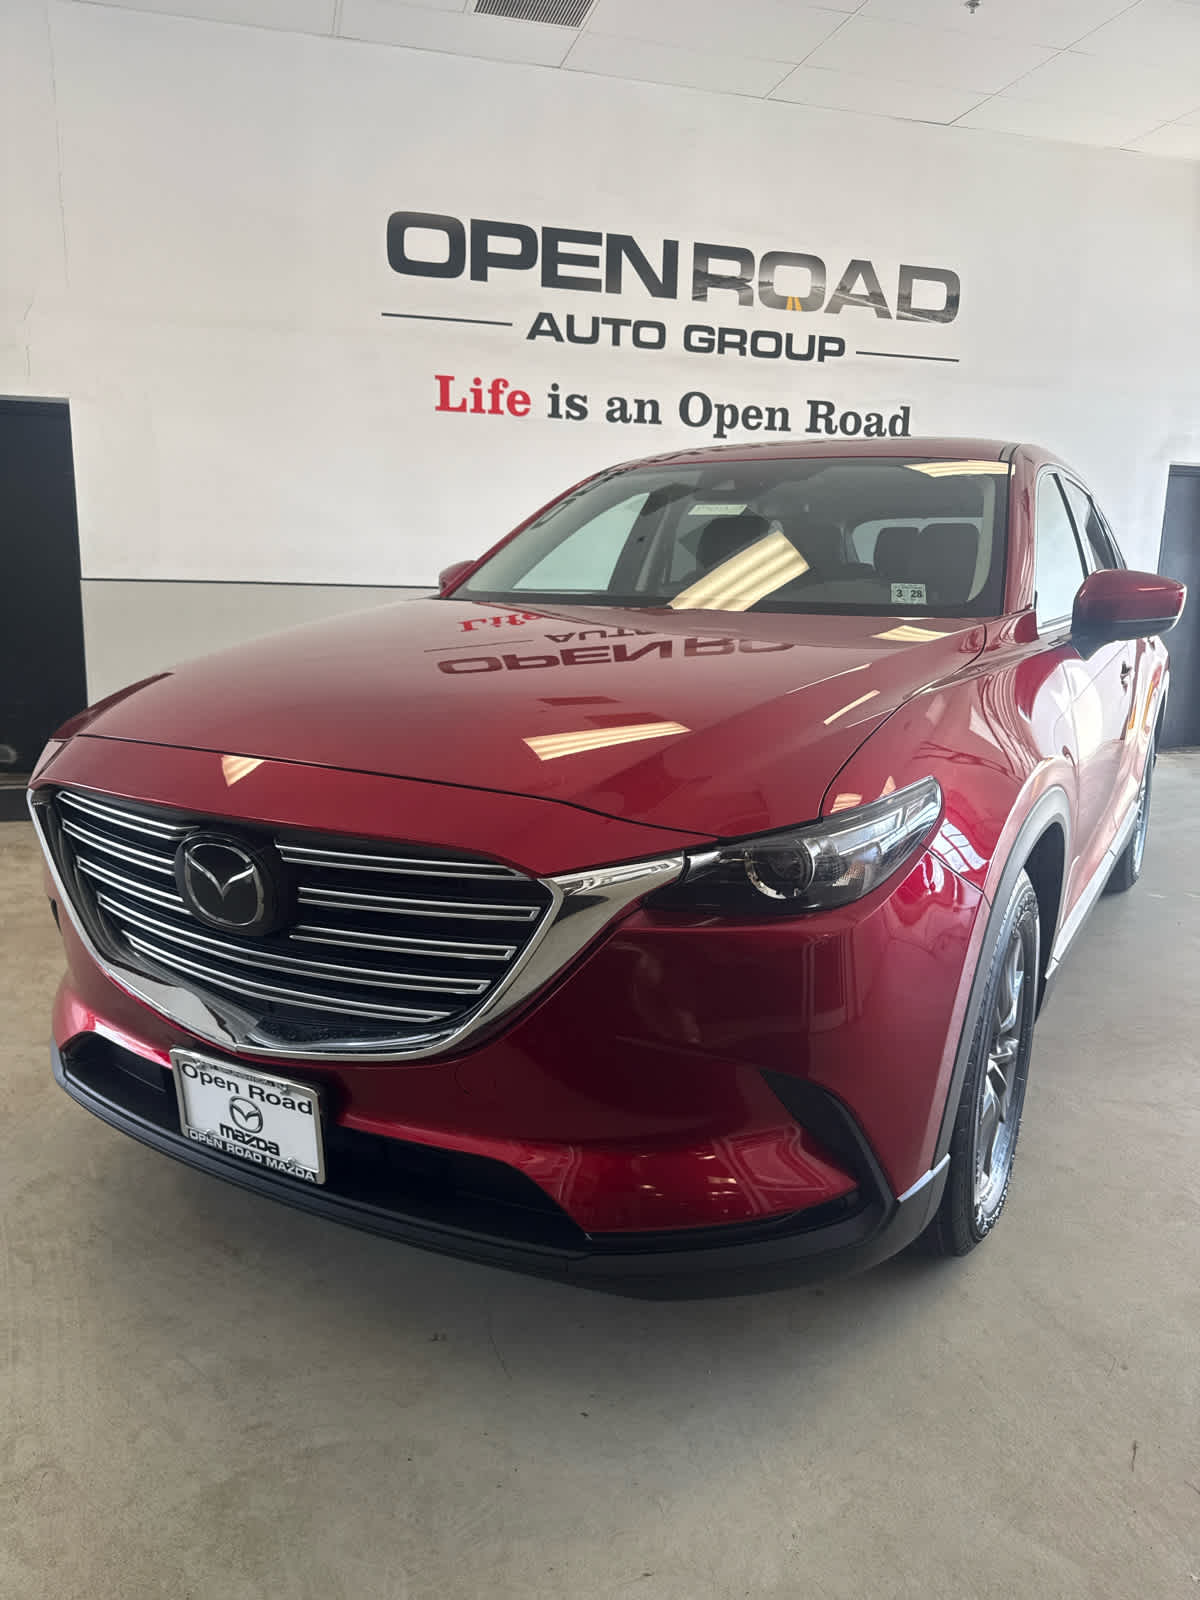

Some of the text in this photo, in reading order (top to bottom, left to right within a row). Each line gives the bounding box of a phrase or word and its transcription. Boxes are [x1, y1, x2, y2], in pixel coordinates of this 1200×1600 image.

[386, 211, 961, 324] OPEN ROAD
[526, 312, 846, 362] AUTO GROUP
[434, 375, 911, 438] Life is an Open Road
[896, 589, 922, 598] 3 28
[181, 1063, 240, 1094] Open
[248, 1084, 313, 1115] Road
[189, 1130, 316, 1182] OPEN ROAD MAZDA
[219, 1123, 281, 1156] mazda
